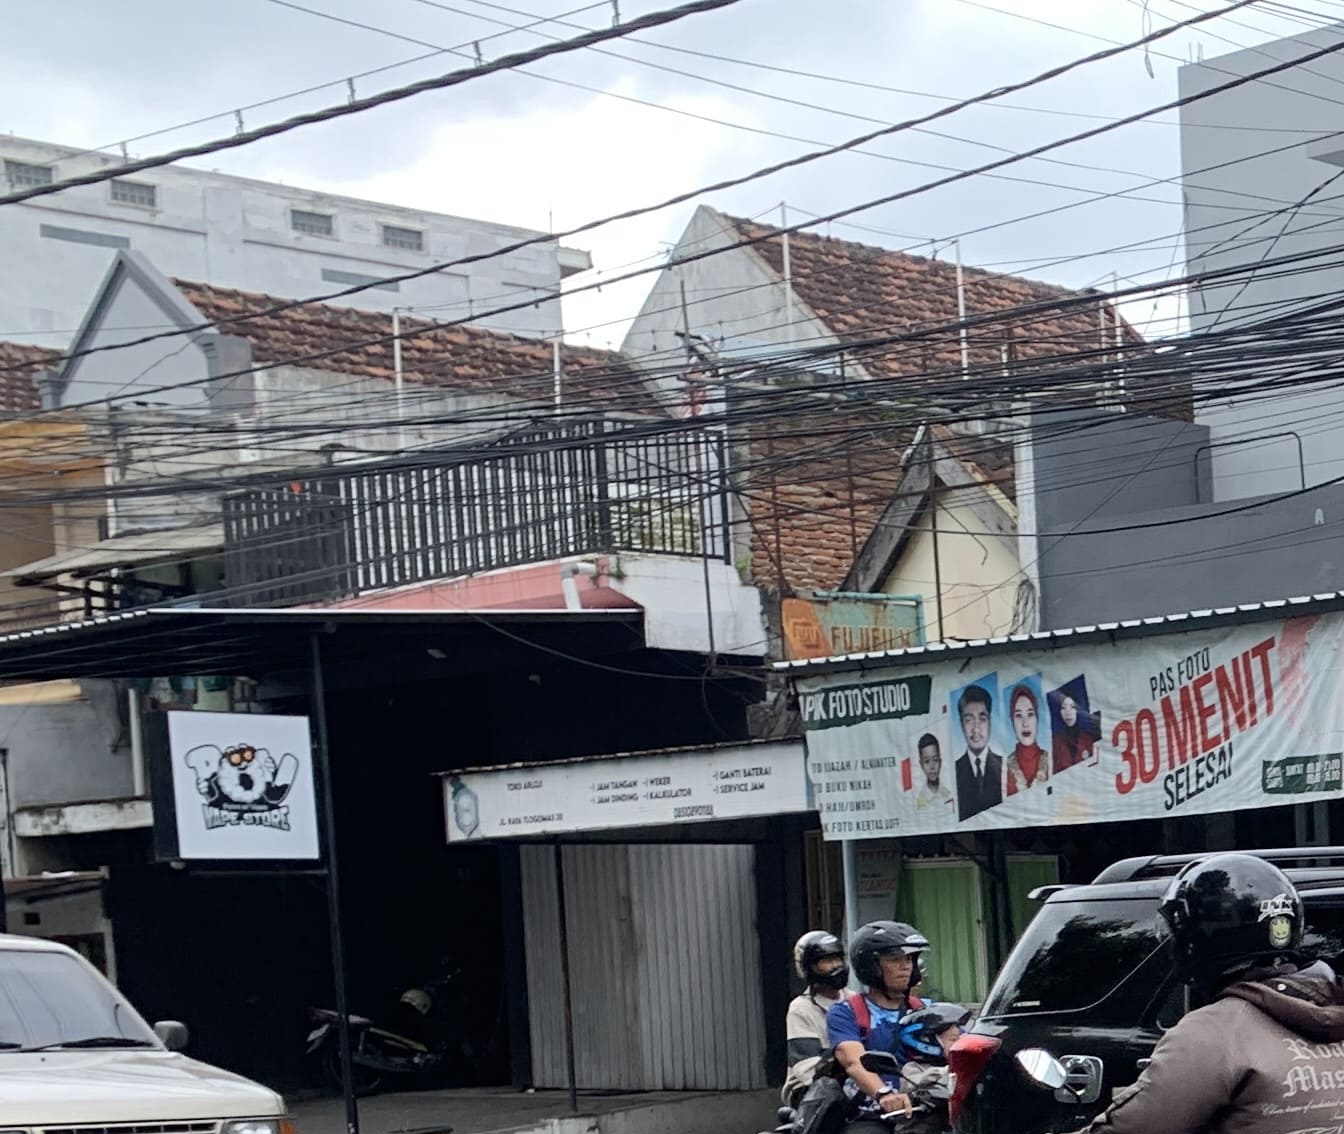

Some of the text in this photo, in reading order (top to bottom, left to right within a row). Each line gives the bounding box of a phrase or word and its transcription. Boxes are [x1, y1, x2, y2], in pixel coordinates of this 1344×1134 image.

[1150, 647, 1211, 700] PAS FOTO
[829, 689, 862, 718] FOTO
[863, 683, 912, 715] STUDIO
[1111, 636, 1276, 795] 30 MENIT
[719, 766, 772, 780] GANTI BATERAI
[1163, 741, 1234, 811] SELESAI
[611, 780, 638, 790] TANGAN
[650, 776, 671, 786] WEKER
[719, 782, 765, 794] SERVICE JAM
[850, 779, 872, 791] NIKAH
[650, 788, 692, 800] KALKULATOR
[242, 805, 292, 832] STORE
[832, 821, 853, 833] FOTO
[855, 819, 884, 832] KERTAS
